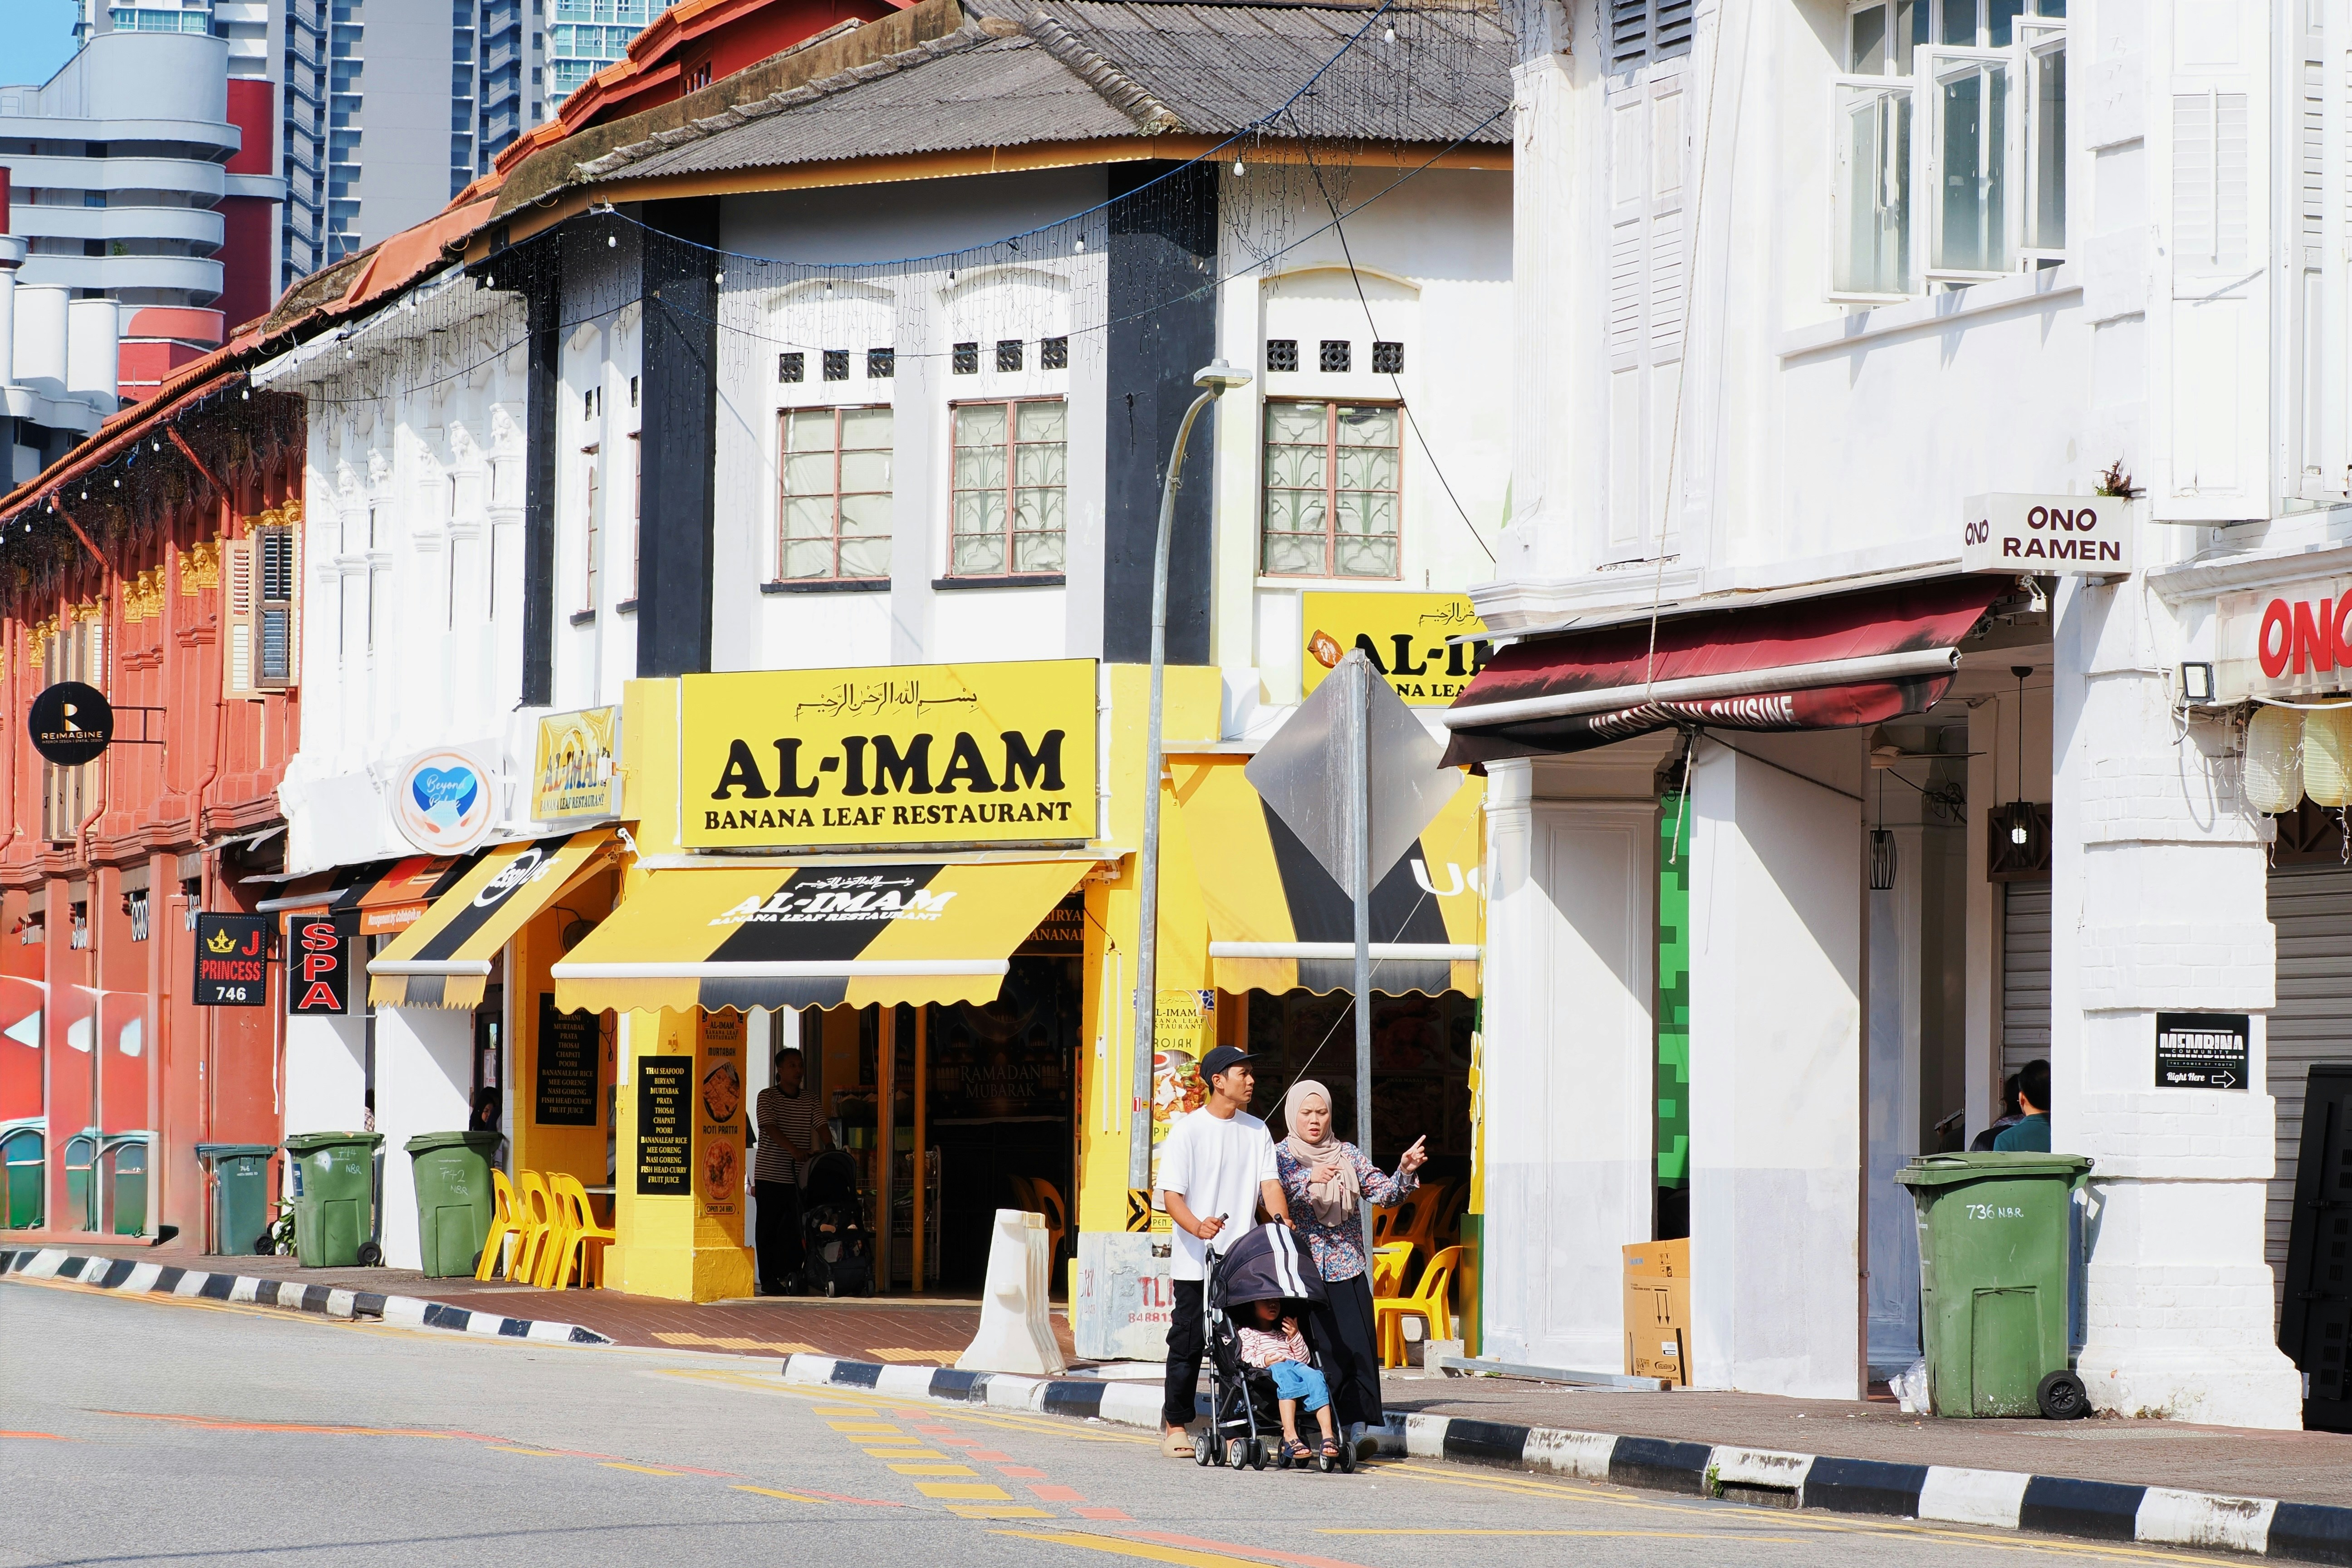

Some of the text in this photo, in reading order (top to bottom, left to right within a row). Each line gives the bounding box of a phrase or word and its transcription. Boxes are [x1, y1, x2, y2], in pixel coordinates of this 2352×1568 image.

[2027, 506, 2097, 532] ONO
[1965, 519, 1989, 546] ONO
[2003, 537, 2121, 561] RAMEN
[1710, 696, 1801, 726] CUISINE
[710, 729, 1066, 799] AL-IMAM
[426, 774, 466, 794] Beyond
[540, 794, 605, 812] BANANA LEAF RESTAURANT
[705, 801, 1072, 829] BANANA LEAF RESTAURANT
[720, 889, 958, 916] AL-IMAM
[707, 914, 777, 926] BANANA
[824, 911, 942, 921] RESTAURANT
[242, 931, 259, 956] J
[201, 960, 260, 981] PRINCESS
[298, 923, 342, 1009] SPA
[216, 986, 246, 1000] 746
[1156, 1009, 1196, 1017] L-IMAM
[960, 1064, 1041, 1083] RAMADAN
[2166, 1072, 2205, 1083] Right Here
[965, 1083, 1036, 1098] MUBARAK
[703, 1125, 738, 1134] ROTI PRATTA
[346, 1164, 362, 1174] NBR
[664, 1176, 680, 1184] JUICE
[450, 1185, 468, 1196] NBR
[1966, 1204, 1994, 1220] 736
